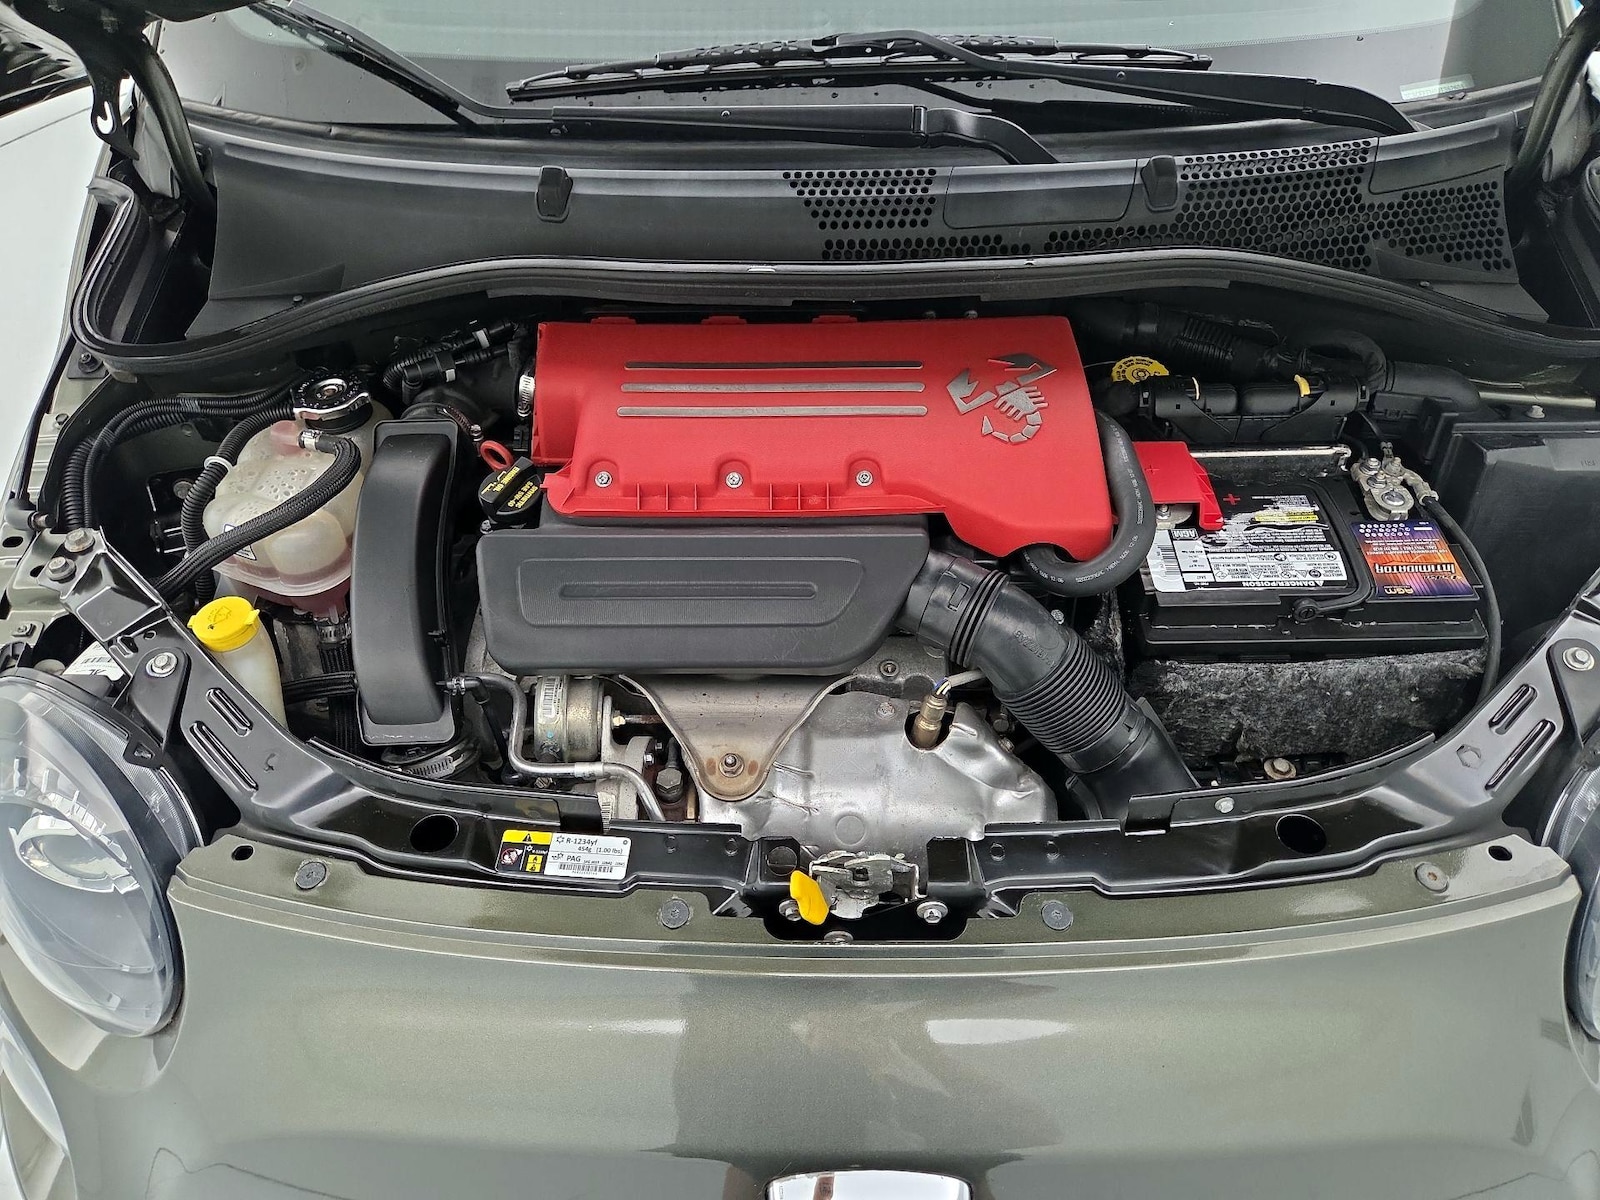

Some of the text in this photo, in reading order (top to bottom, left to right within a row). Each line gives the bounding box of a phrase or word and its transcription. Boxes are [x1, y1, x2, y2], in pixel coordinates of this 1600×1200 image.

[1174, 530, 1196, 539] AGM
[566, 837, 598, 846] R-1234yf
[596, 846, 611, 854] (1.00
[566, 855, 581, 863] PAG
